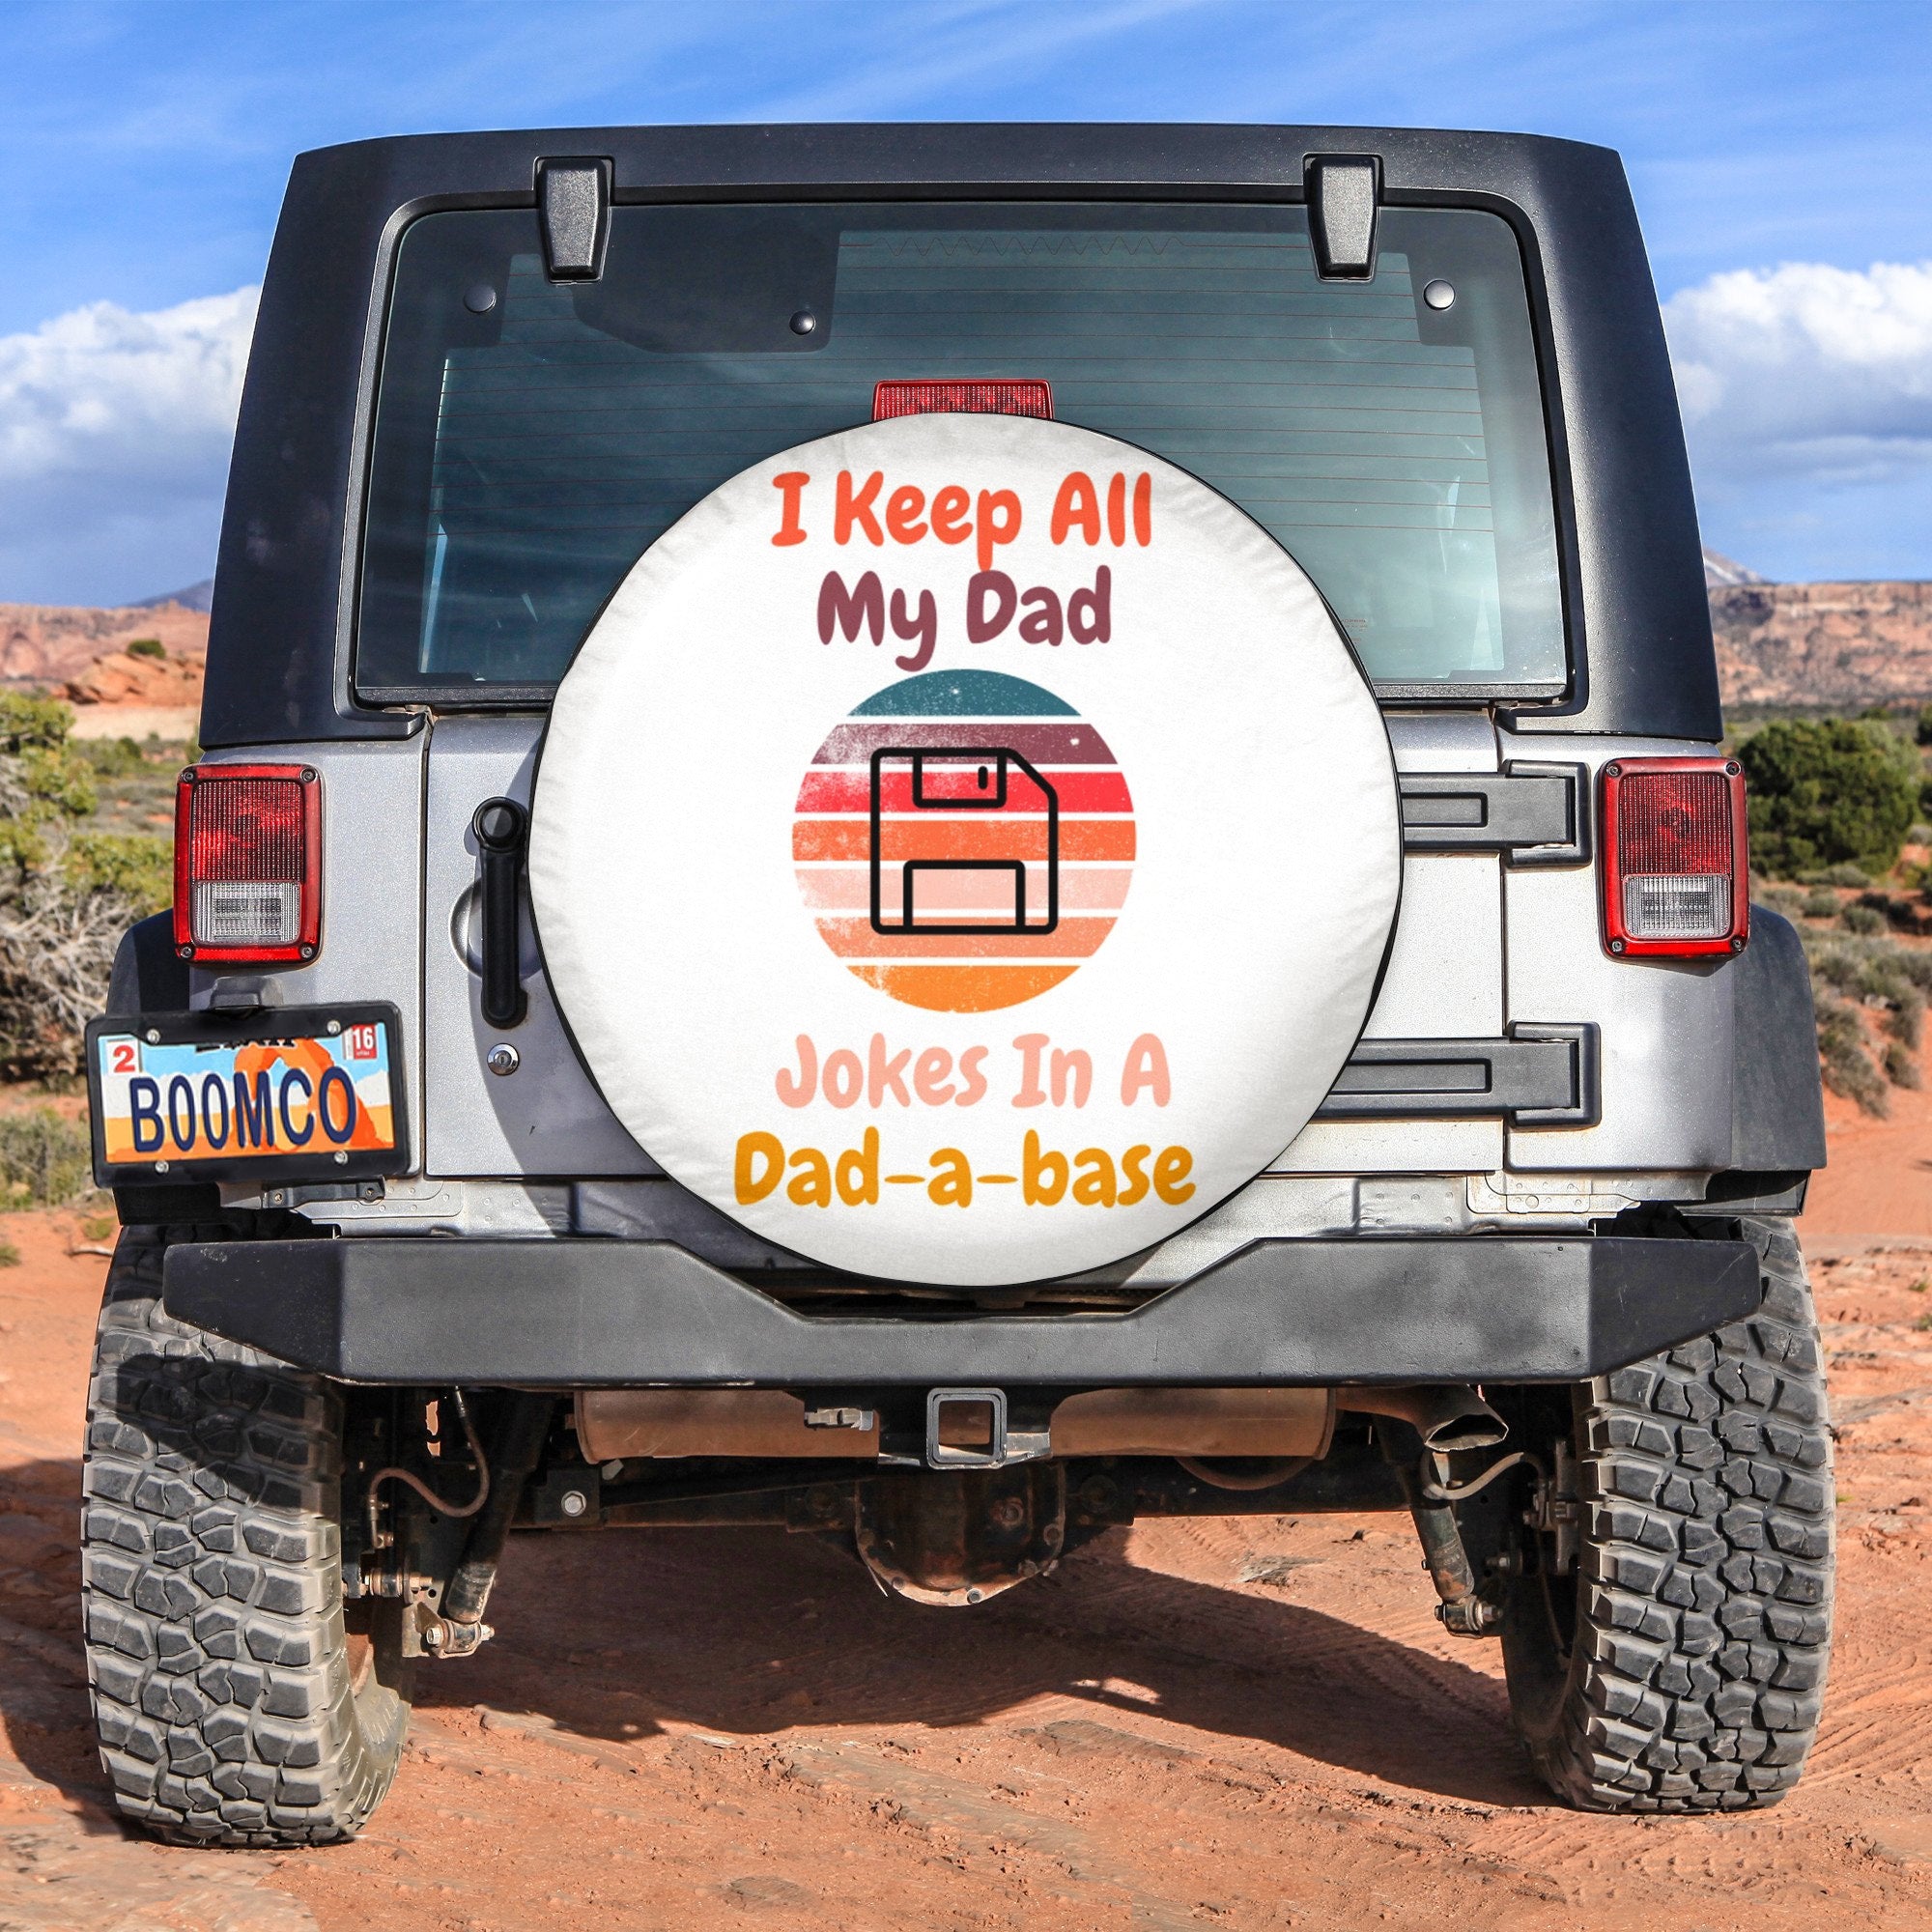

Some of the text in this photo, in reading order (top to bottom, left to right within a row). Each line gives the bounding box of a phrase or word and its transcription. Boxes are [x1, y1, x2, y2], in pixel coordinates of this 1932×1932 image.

[771, 469, 1152, 573] I Keep All
[817, 564, 1112, 672] My Dad
[112, 1044, 136, 1073] 2
[353, 1027, 375, 1050] 16
[775, 1032, 1172, 1110] Jokes In A
[733, 1125, 1197, 1209] Dad-a-base
